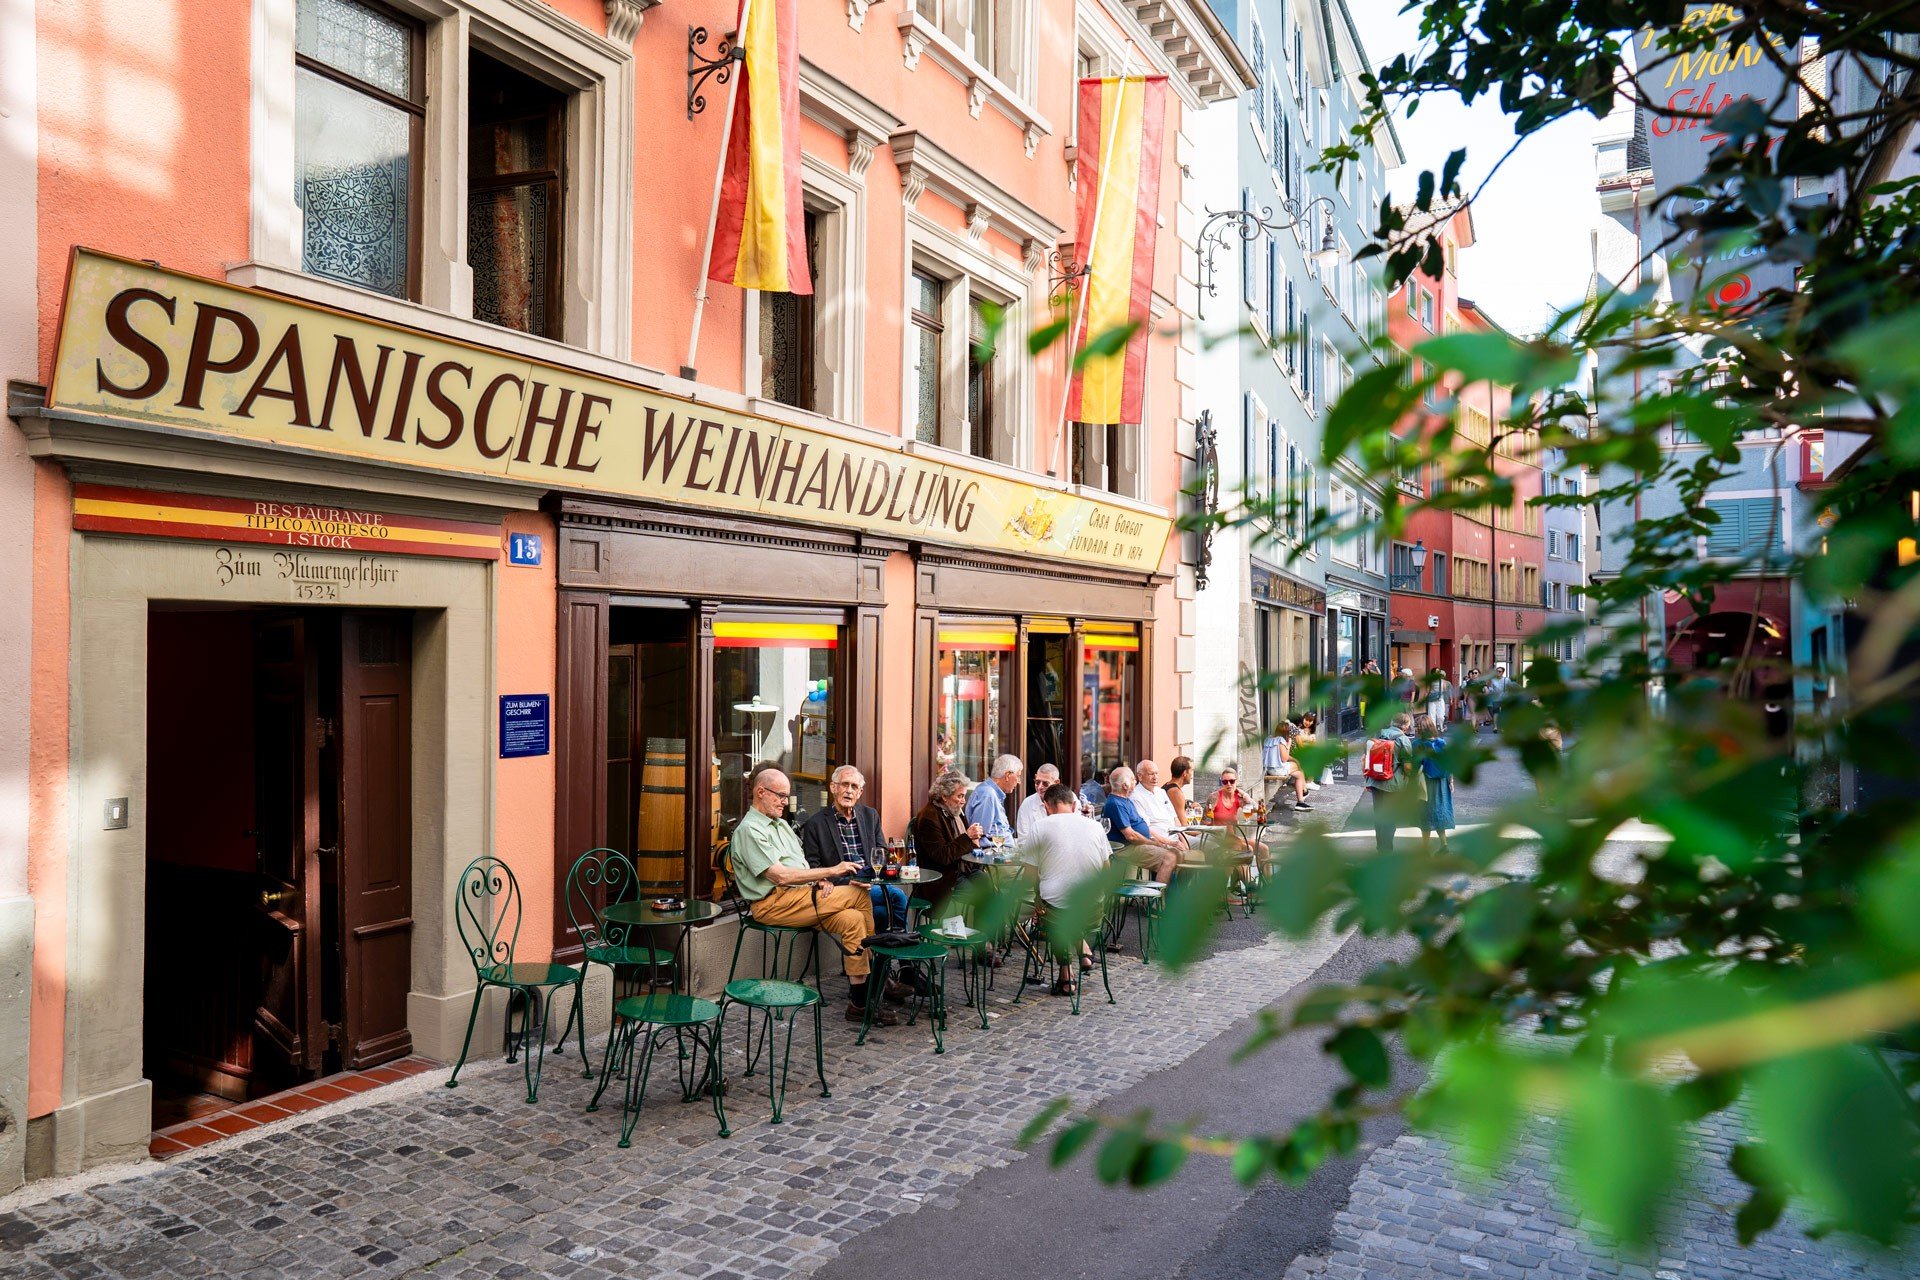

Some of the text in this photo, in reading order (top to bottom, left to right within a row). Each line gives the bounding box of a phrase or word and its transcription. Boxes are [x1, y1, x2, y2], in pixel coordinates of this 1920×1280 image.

[97, 287, 980, 533] SPANISCHE WEINHANDLUNG
[244, 514, 388, 538] TIPICO MORESCO
[254, 502, 383, 526] RESTAURANTE
[514, 538, 537, 560] 15
[1069, 535, 1143, 561] FUNDADA EN 1874
[295, 585, 336, 600] 1524
[505, 708, 531, 716] GESCHIRR
